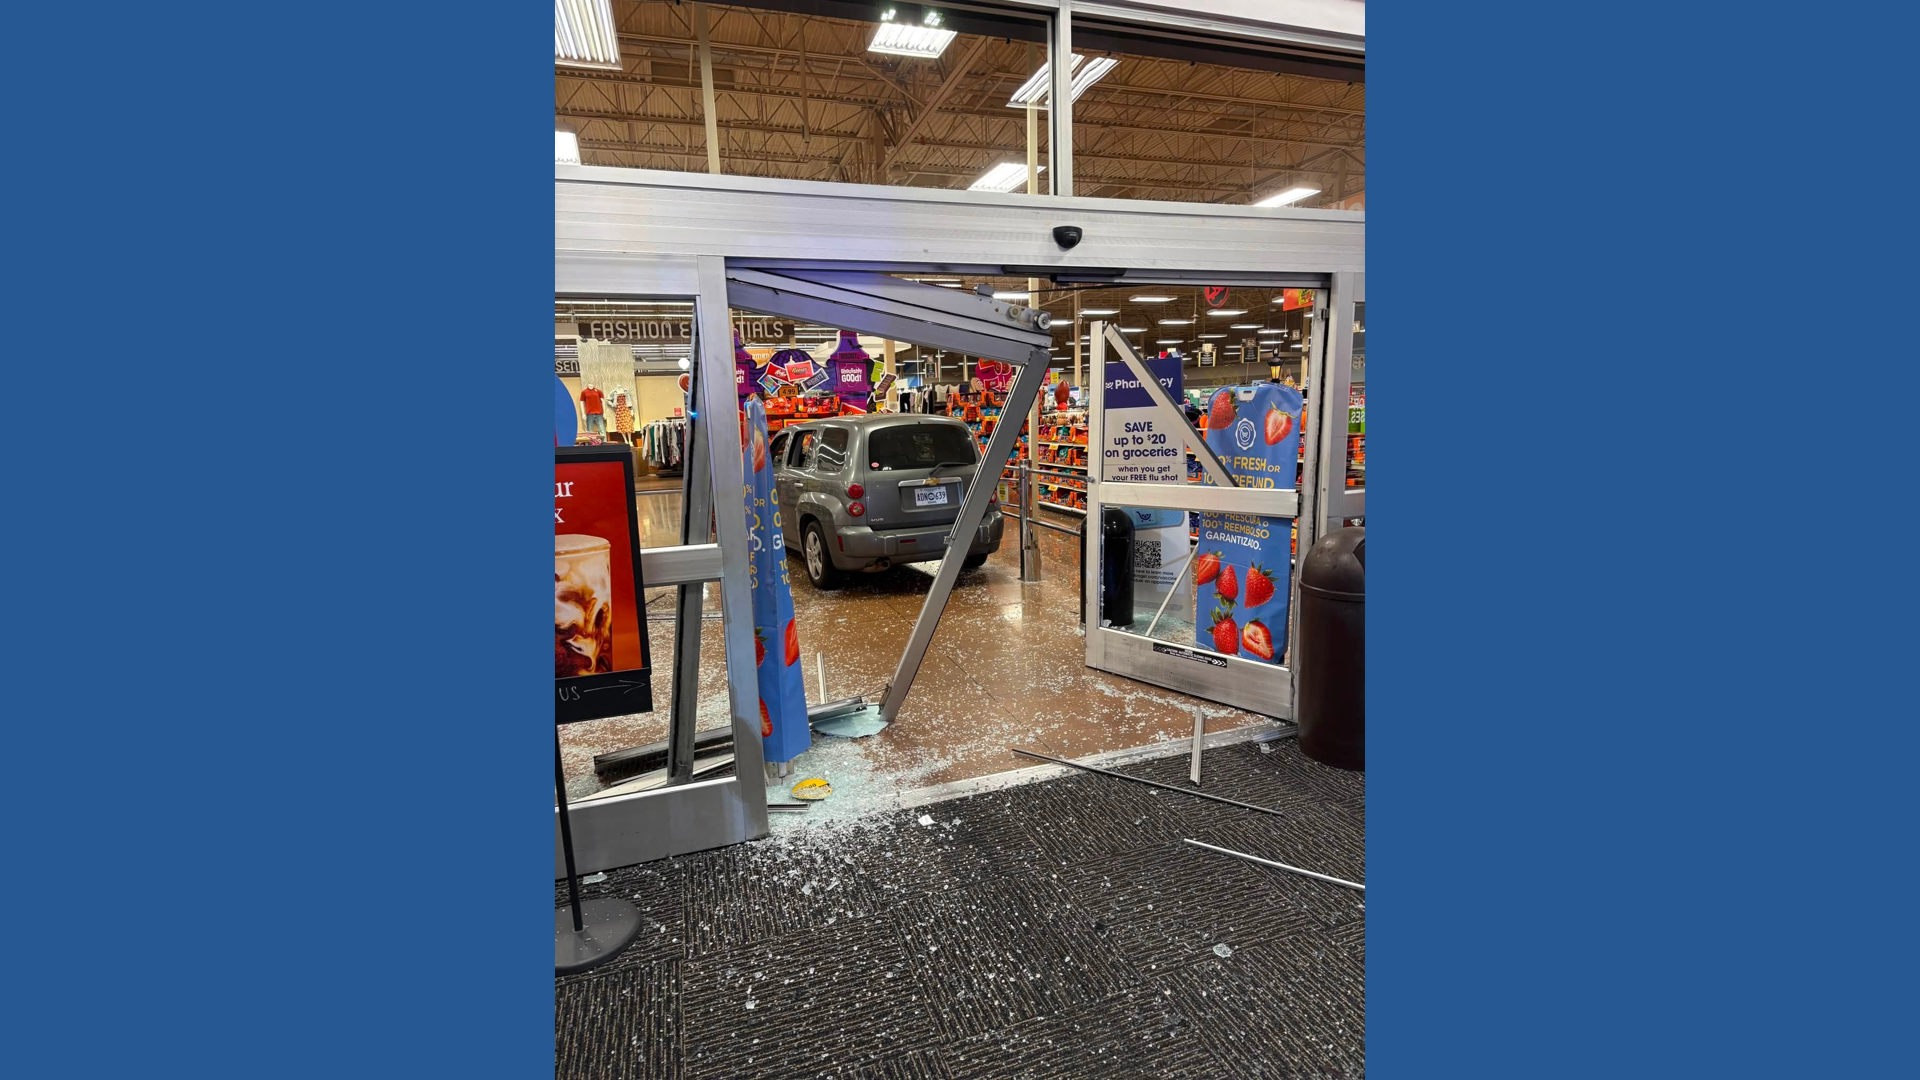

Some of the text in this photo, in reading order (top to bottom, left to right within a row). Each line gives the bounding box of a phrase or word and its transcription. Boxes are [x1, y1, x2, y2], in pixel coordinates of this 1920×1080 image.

[590, 320, 672, 339] FASHION
[555, 360, 578, 372] SEN
[1115, 377, 1173, 389] Pharcy
[1125, 422, 1153, 432] SAVE
[1114, 433, 1166, 447] up to $20
[1105, 446, 1178, 460] on groceries
[1157, 465, 1170, 473] get
[1233, 456, 1267, 471] FRESH
[1267, 465, 1281, 473] OR
[1225, 513, 1261, 527] FRESCUA
